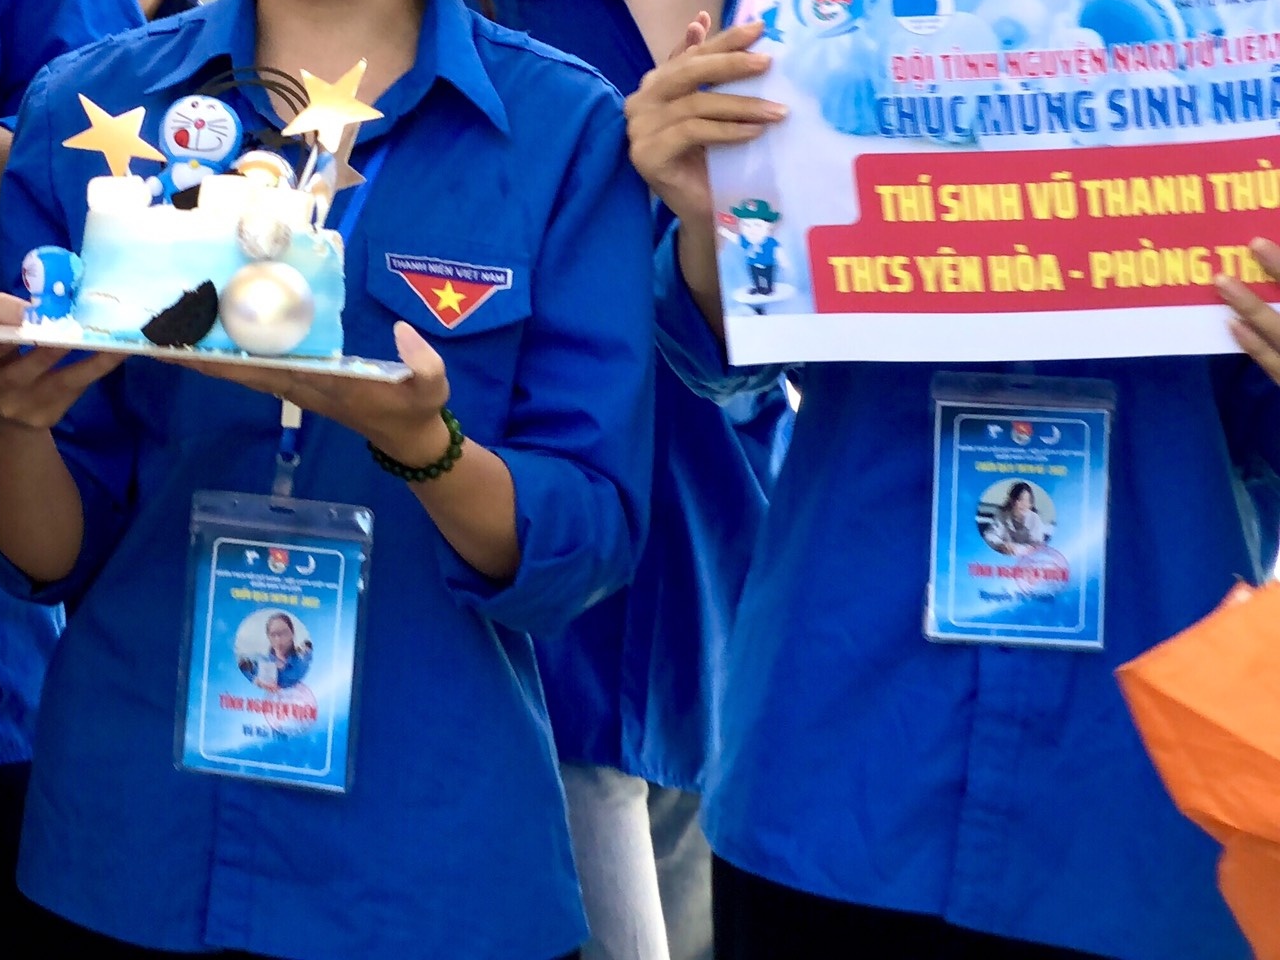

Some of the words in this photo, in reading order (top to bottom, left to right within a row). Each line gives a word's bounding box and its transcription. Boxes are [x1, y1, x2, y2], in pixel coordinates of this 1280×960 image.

[876, 83, 969, 139] CHÚC
[1108, 85, 1200, 131] SINH
[874, 174, 936, 222] THÍ
[937, 183, 1024, 222] SINH
[1025, 171, 1080, 220] VŨ
[1079, 174, 1206, 218] THANH
[391, 258, 427, 272] THANH
[480, 271, 506, 283] NAM
[827, 255, 914, 293] THCS
[913, 246, 986, 293] YÊN
[986, 244, 1066, 292] HÒA
[1088, 237, 1214, 289] PHÒNG
